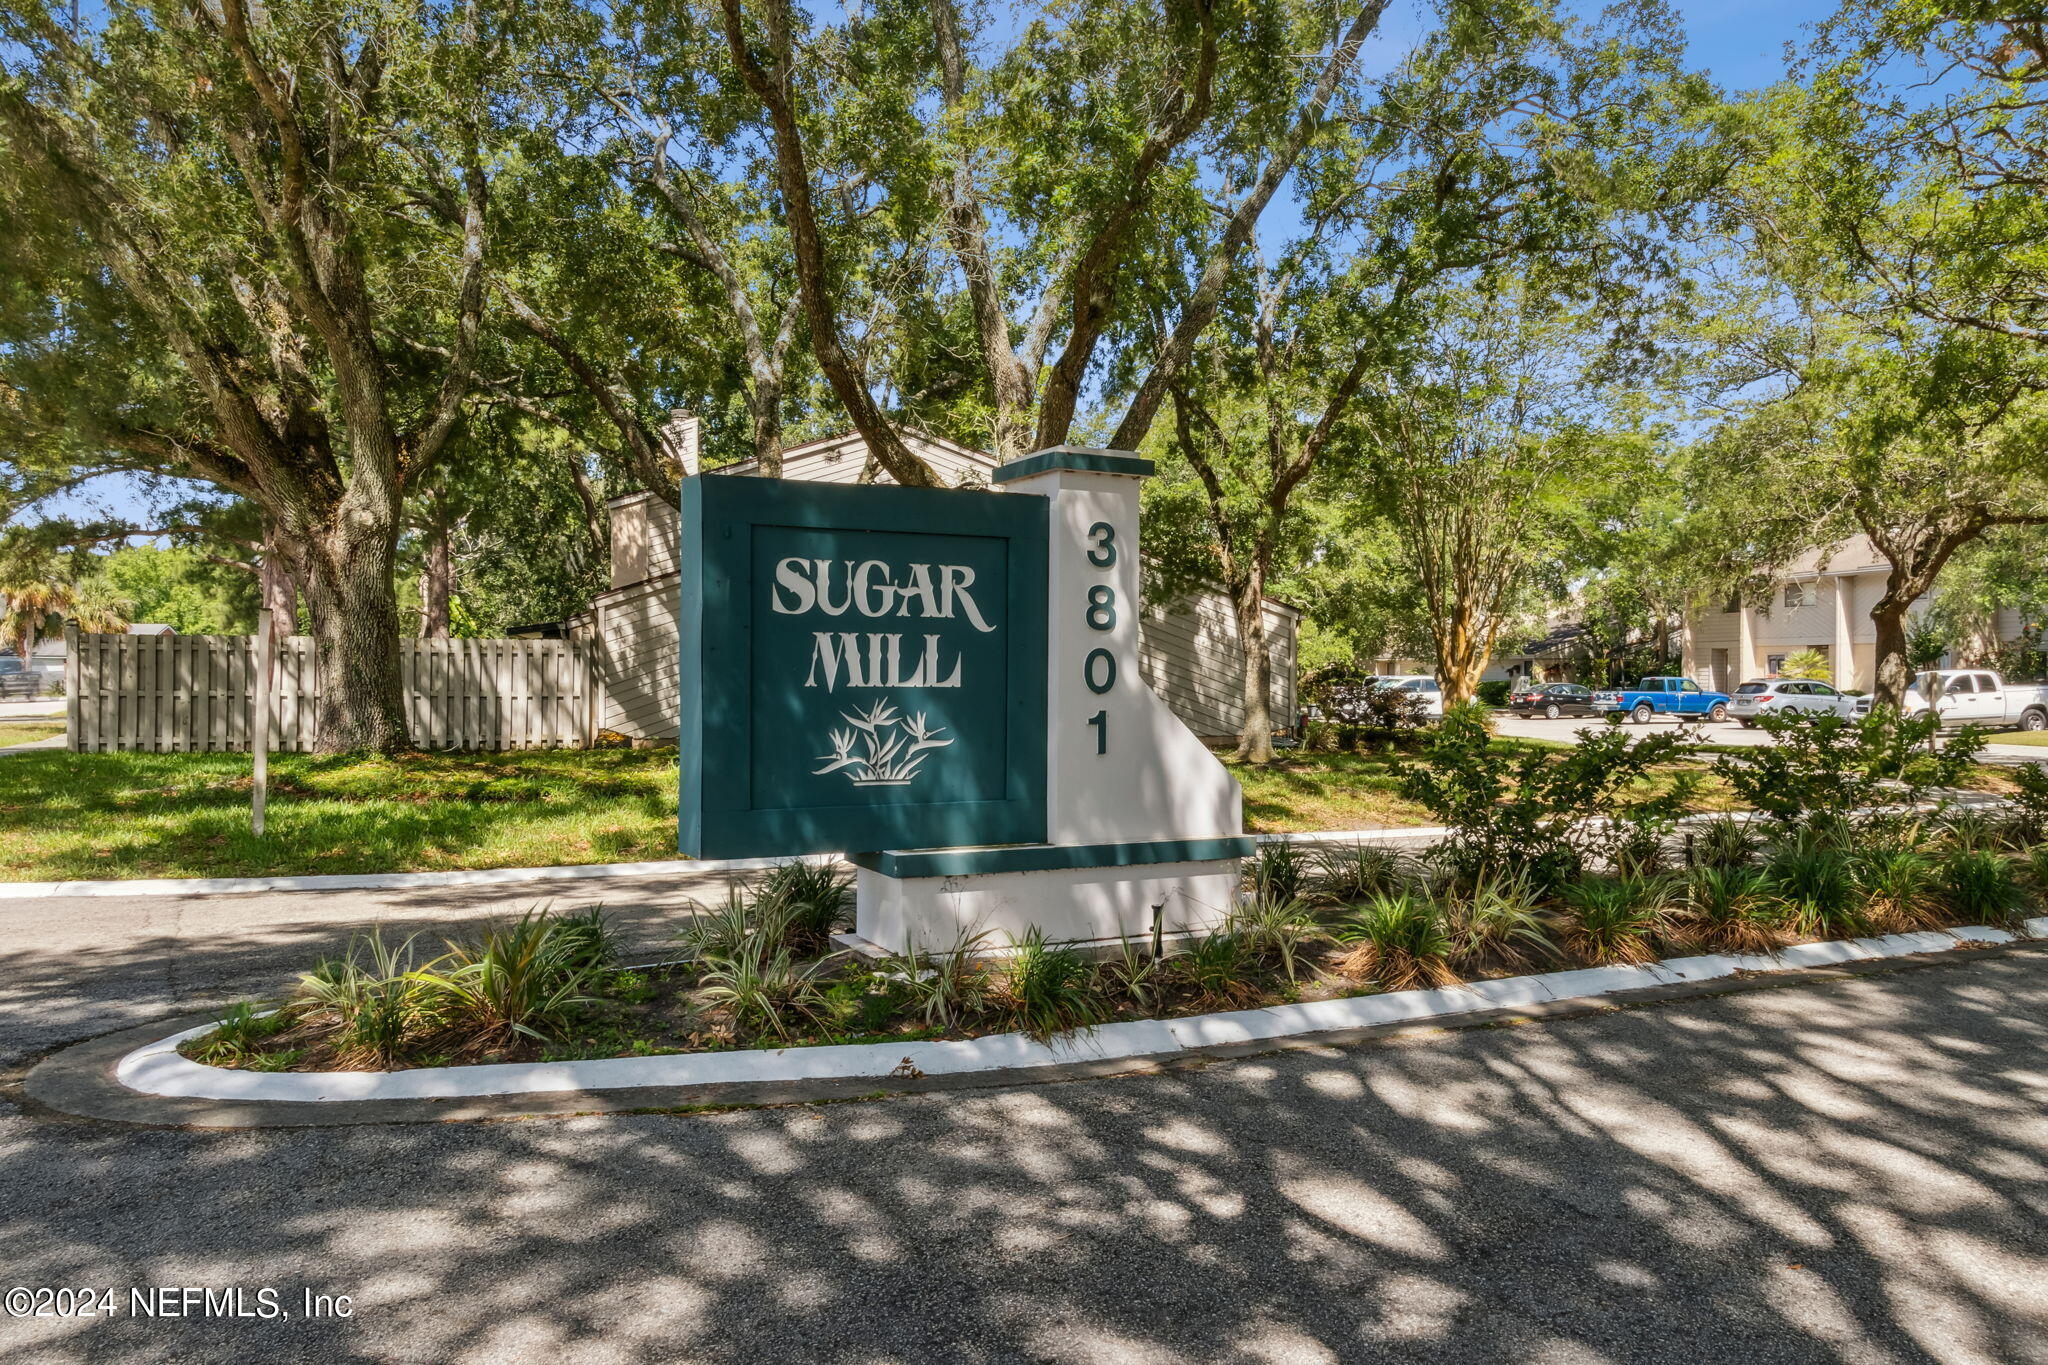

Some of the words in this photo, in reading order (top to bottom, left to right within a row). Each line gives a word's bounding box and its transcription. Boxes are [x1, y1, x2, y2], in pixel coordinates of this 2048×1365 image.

[771, 557, 996, 632] SUGAR
[804, 632, 961, 693] MILL
[1084, 522, 1117, 755] 3801
